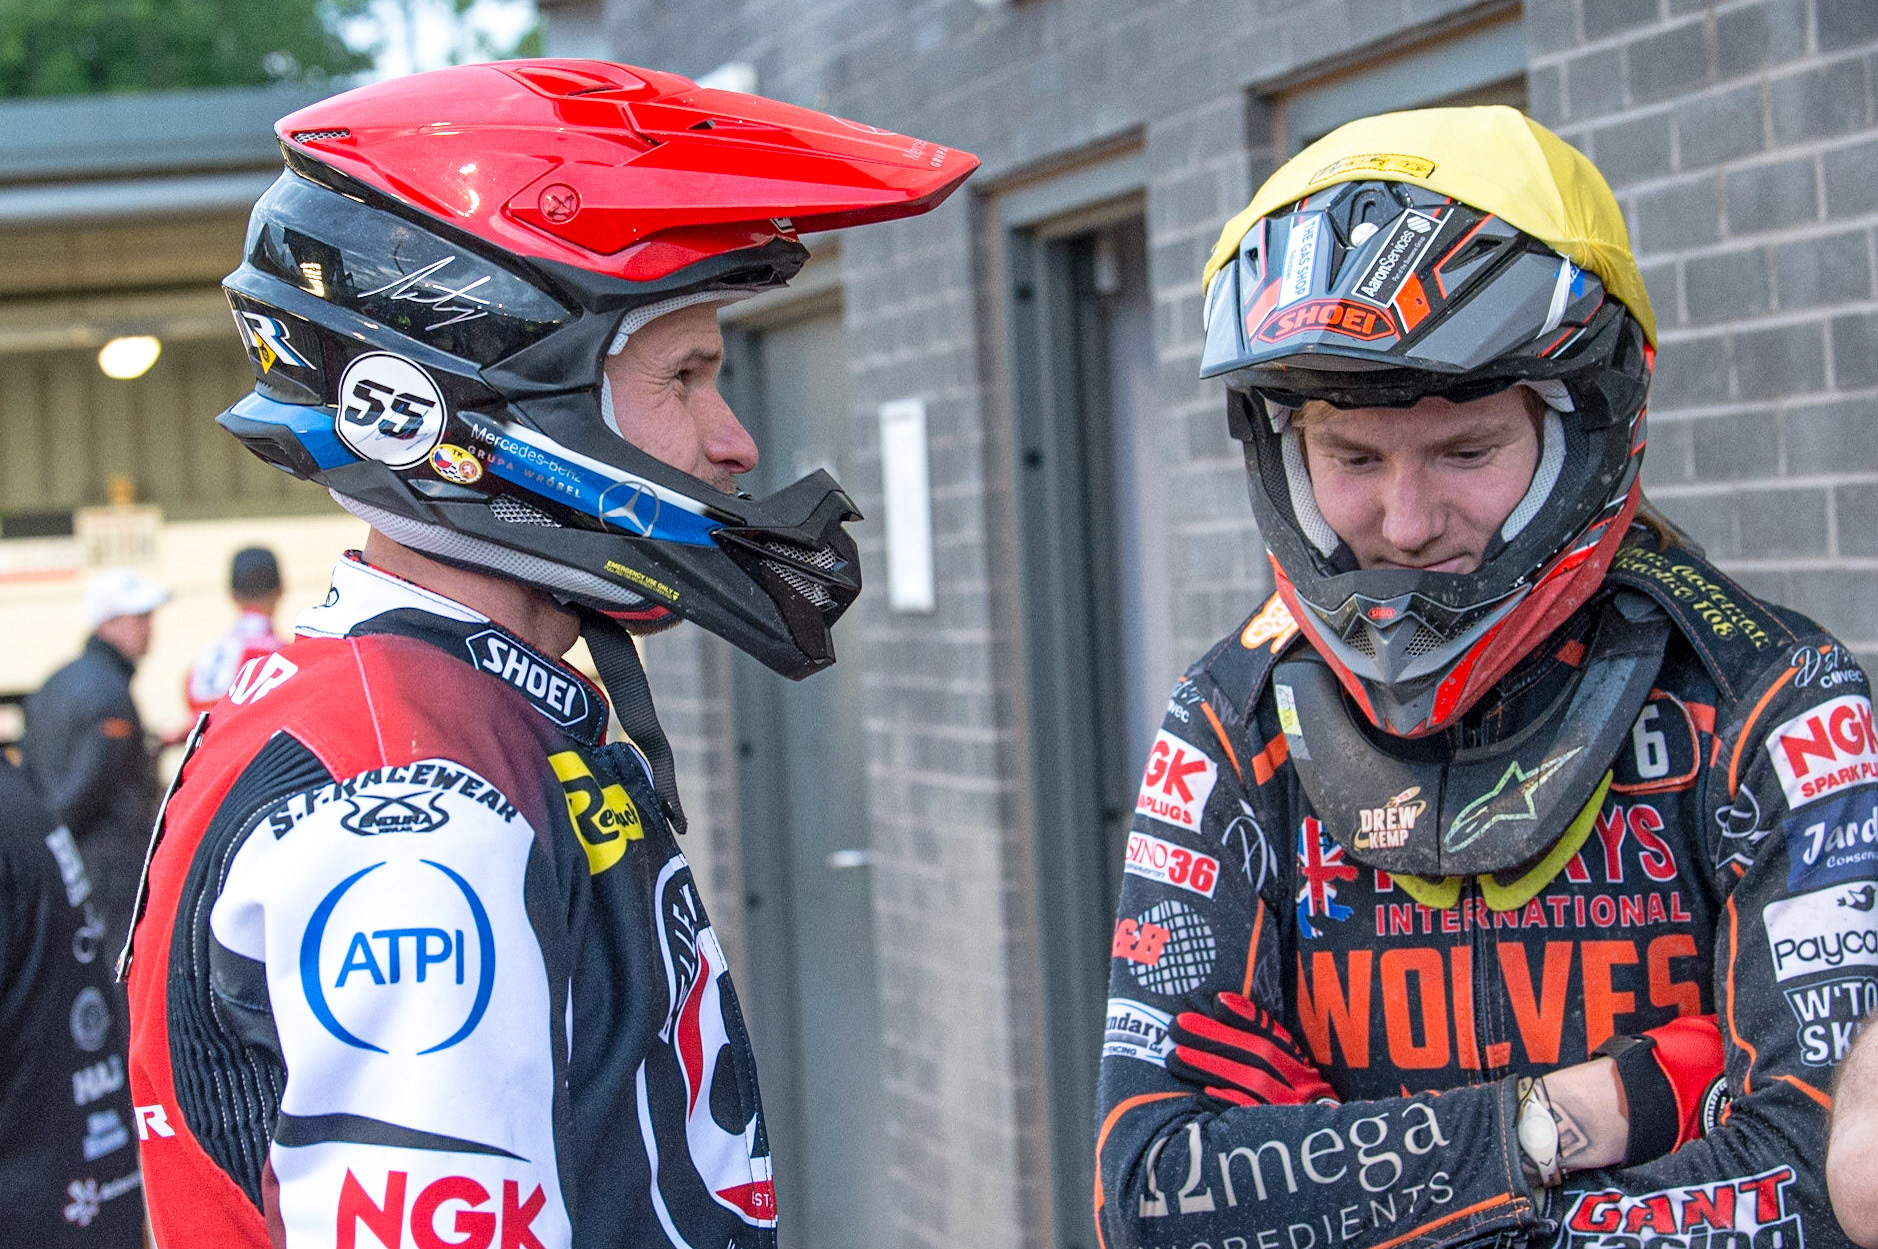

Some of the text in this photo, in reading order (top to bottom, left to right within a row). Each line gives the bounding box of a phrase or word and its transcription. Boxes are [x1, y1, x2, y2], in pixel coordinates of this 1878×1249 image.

[1294, 219, 1316, 296] THE GAS SHOP
[1275, 304, 1377, 336] SHOEI
[345, 379, 436, 440] 55
[467, 444, 581, 499] GRUPA WRÓBEL
[470, 423, 584, 483] Mercedes-Benz
[482, 637, 577, 717] SHOEI
[1780, 702, 1877, 779] NGK
[1801, 764, 1860, 798] SPARK
[1359, 805, 1418, 833] DREW
[1368, 828, 1409, 850] KEMP
[1168, 848, 1218, 893] 36
[1375, 891, 1692, 937] INTERNATIONAL
[334, 927, 465, 989] ATPI
[1297, 934, 1701, 1071] WOLVES
[336, 1166, 548, 1249] NGK
[1568, 1168, 1793, 1235] GANT
